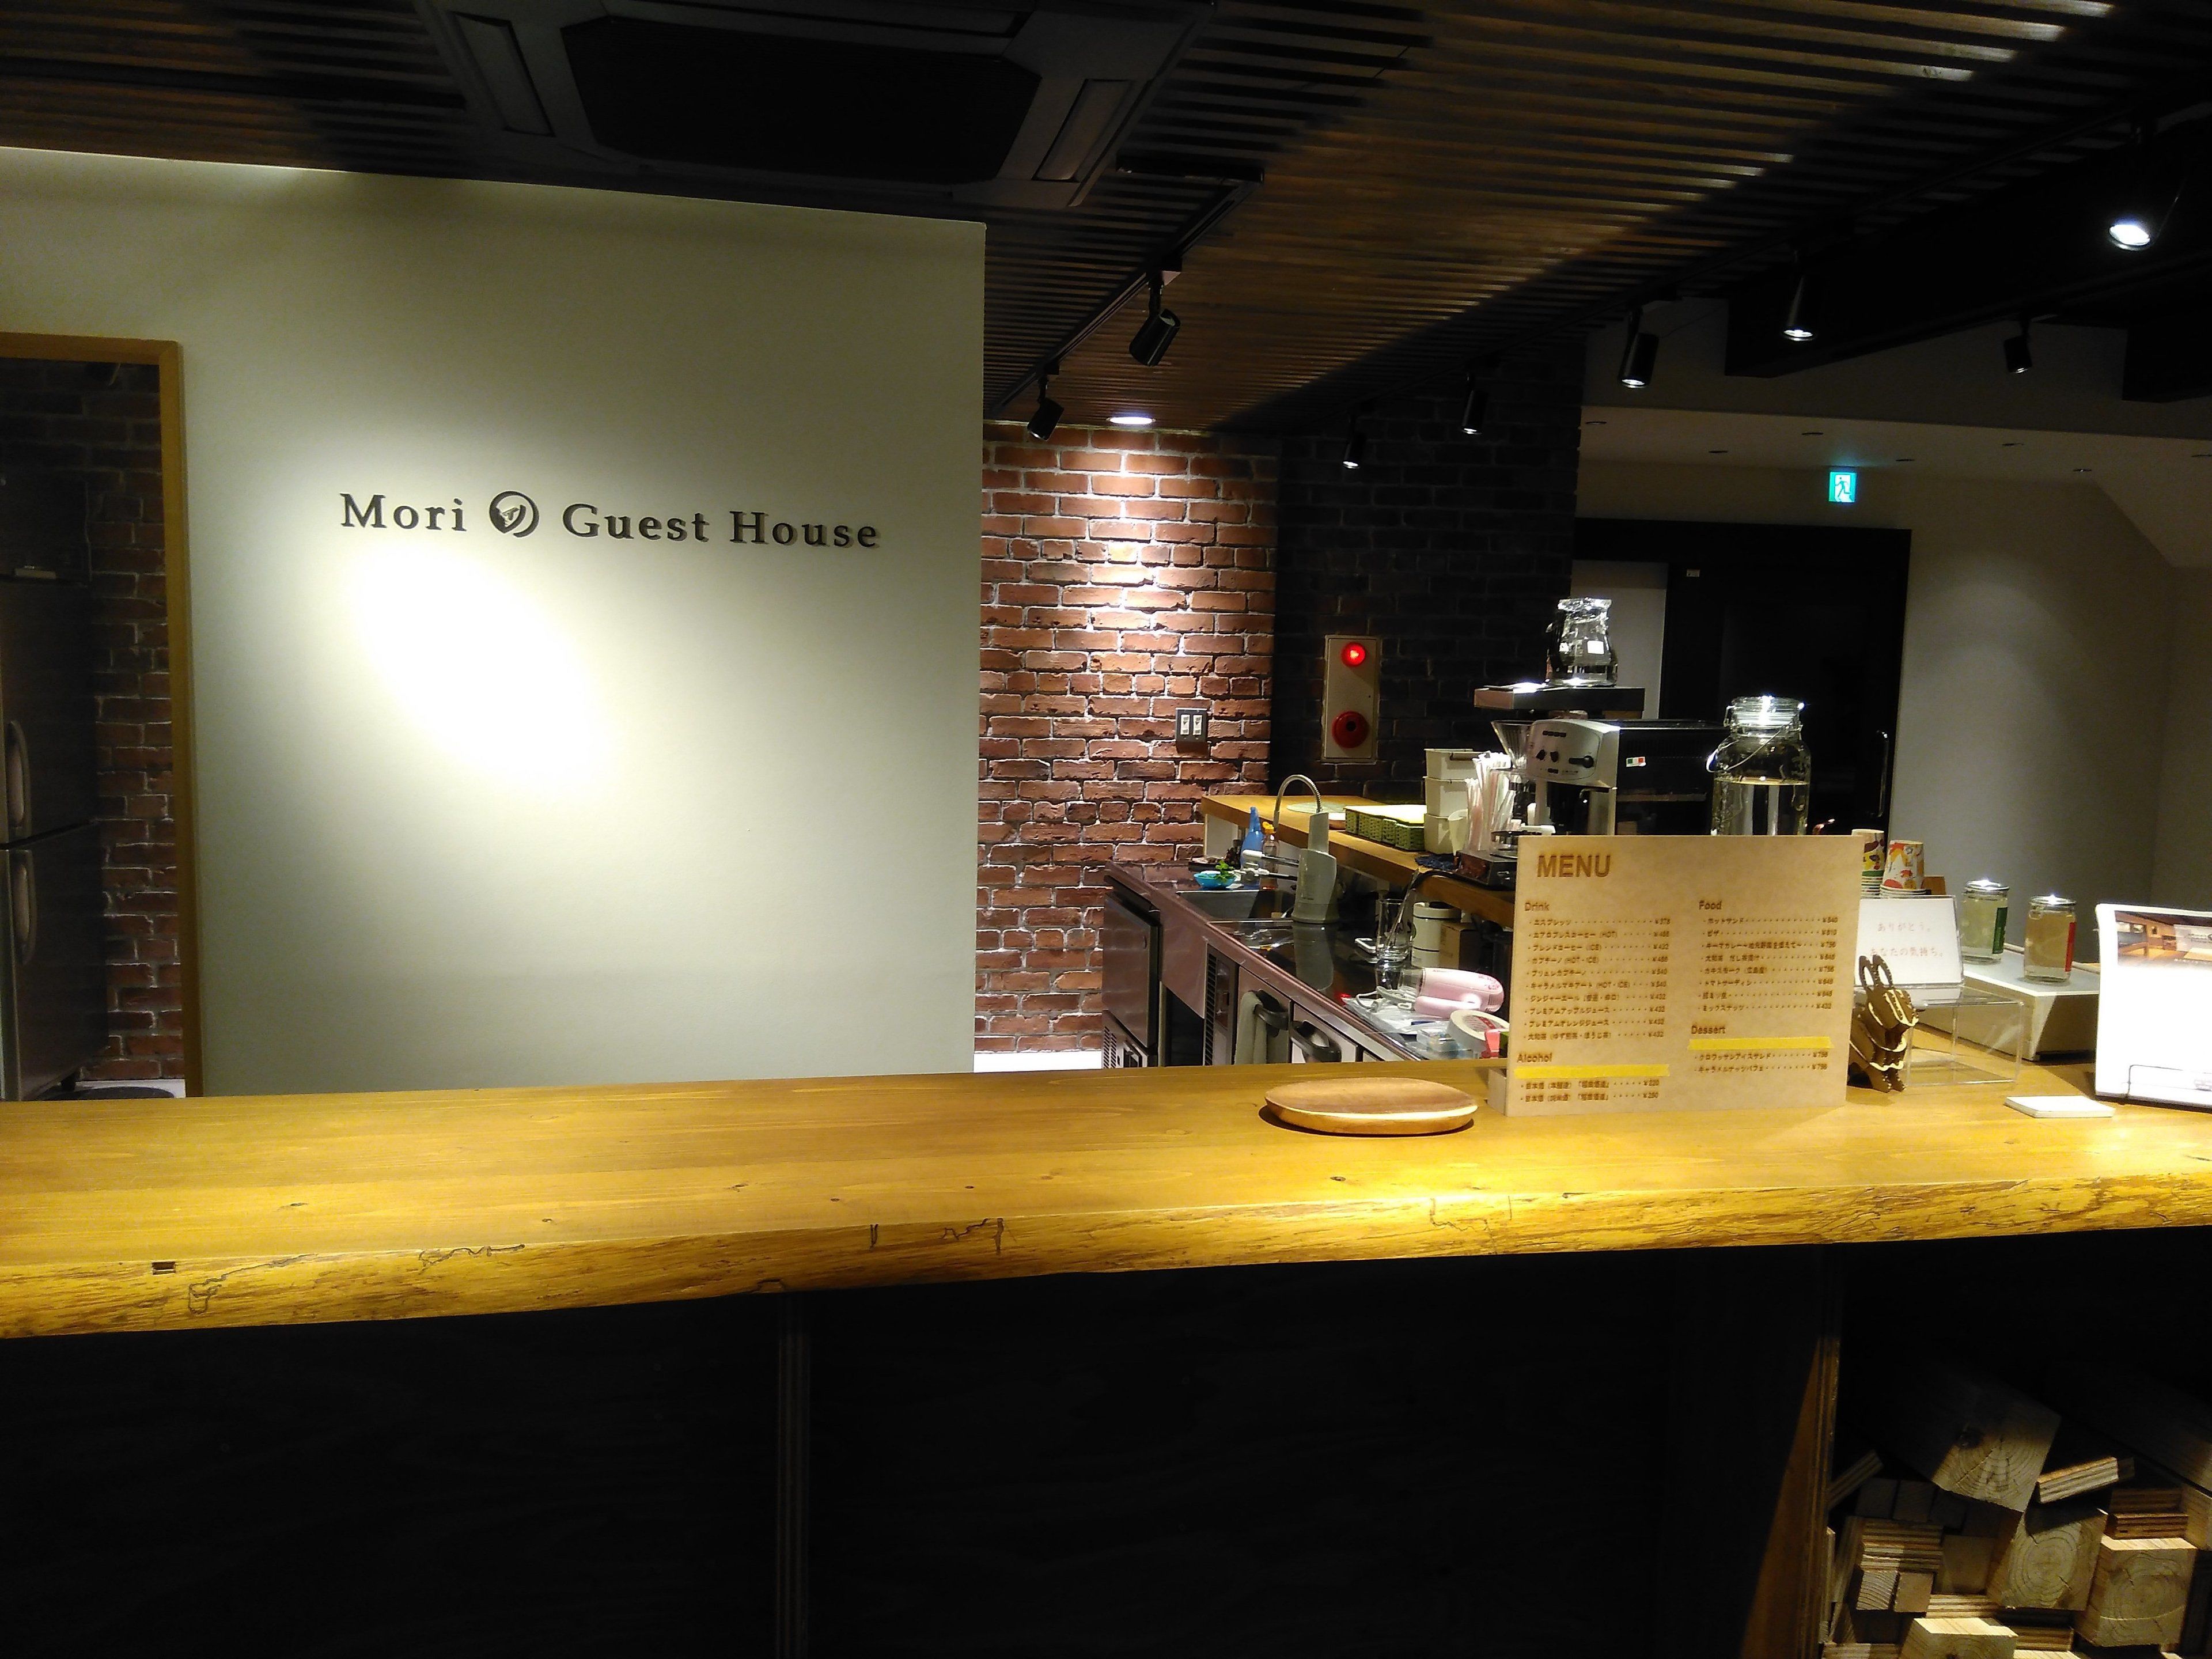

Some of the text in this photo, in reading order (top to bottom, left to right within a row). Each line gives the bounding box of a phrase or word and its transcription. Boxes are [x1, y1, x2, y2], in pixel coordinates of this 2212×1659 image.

[340, 492, 880, 550] Mori Guest House
[1537, 854, 1612, 878] MENU
[1524, 902, 1550, 911] Drink
[1699, 900, 1722, 910] Food
[1691, 1025, 1726, 1035] Dessert
[1517, 1052, 1553, 1063] Alcohol
